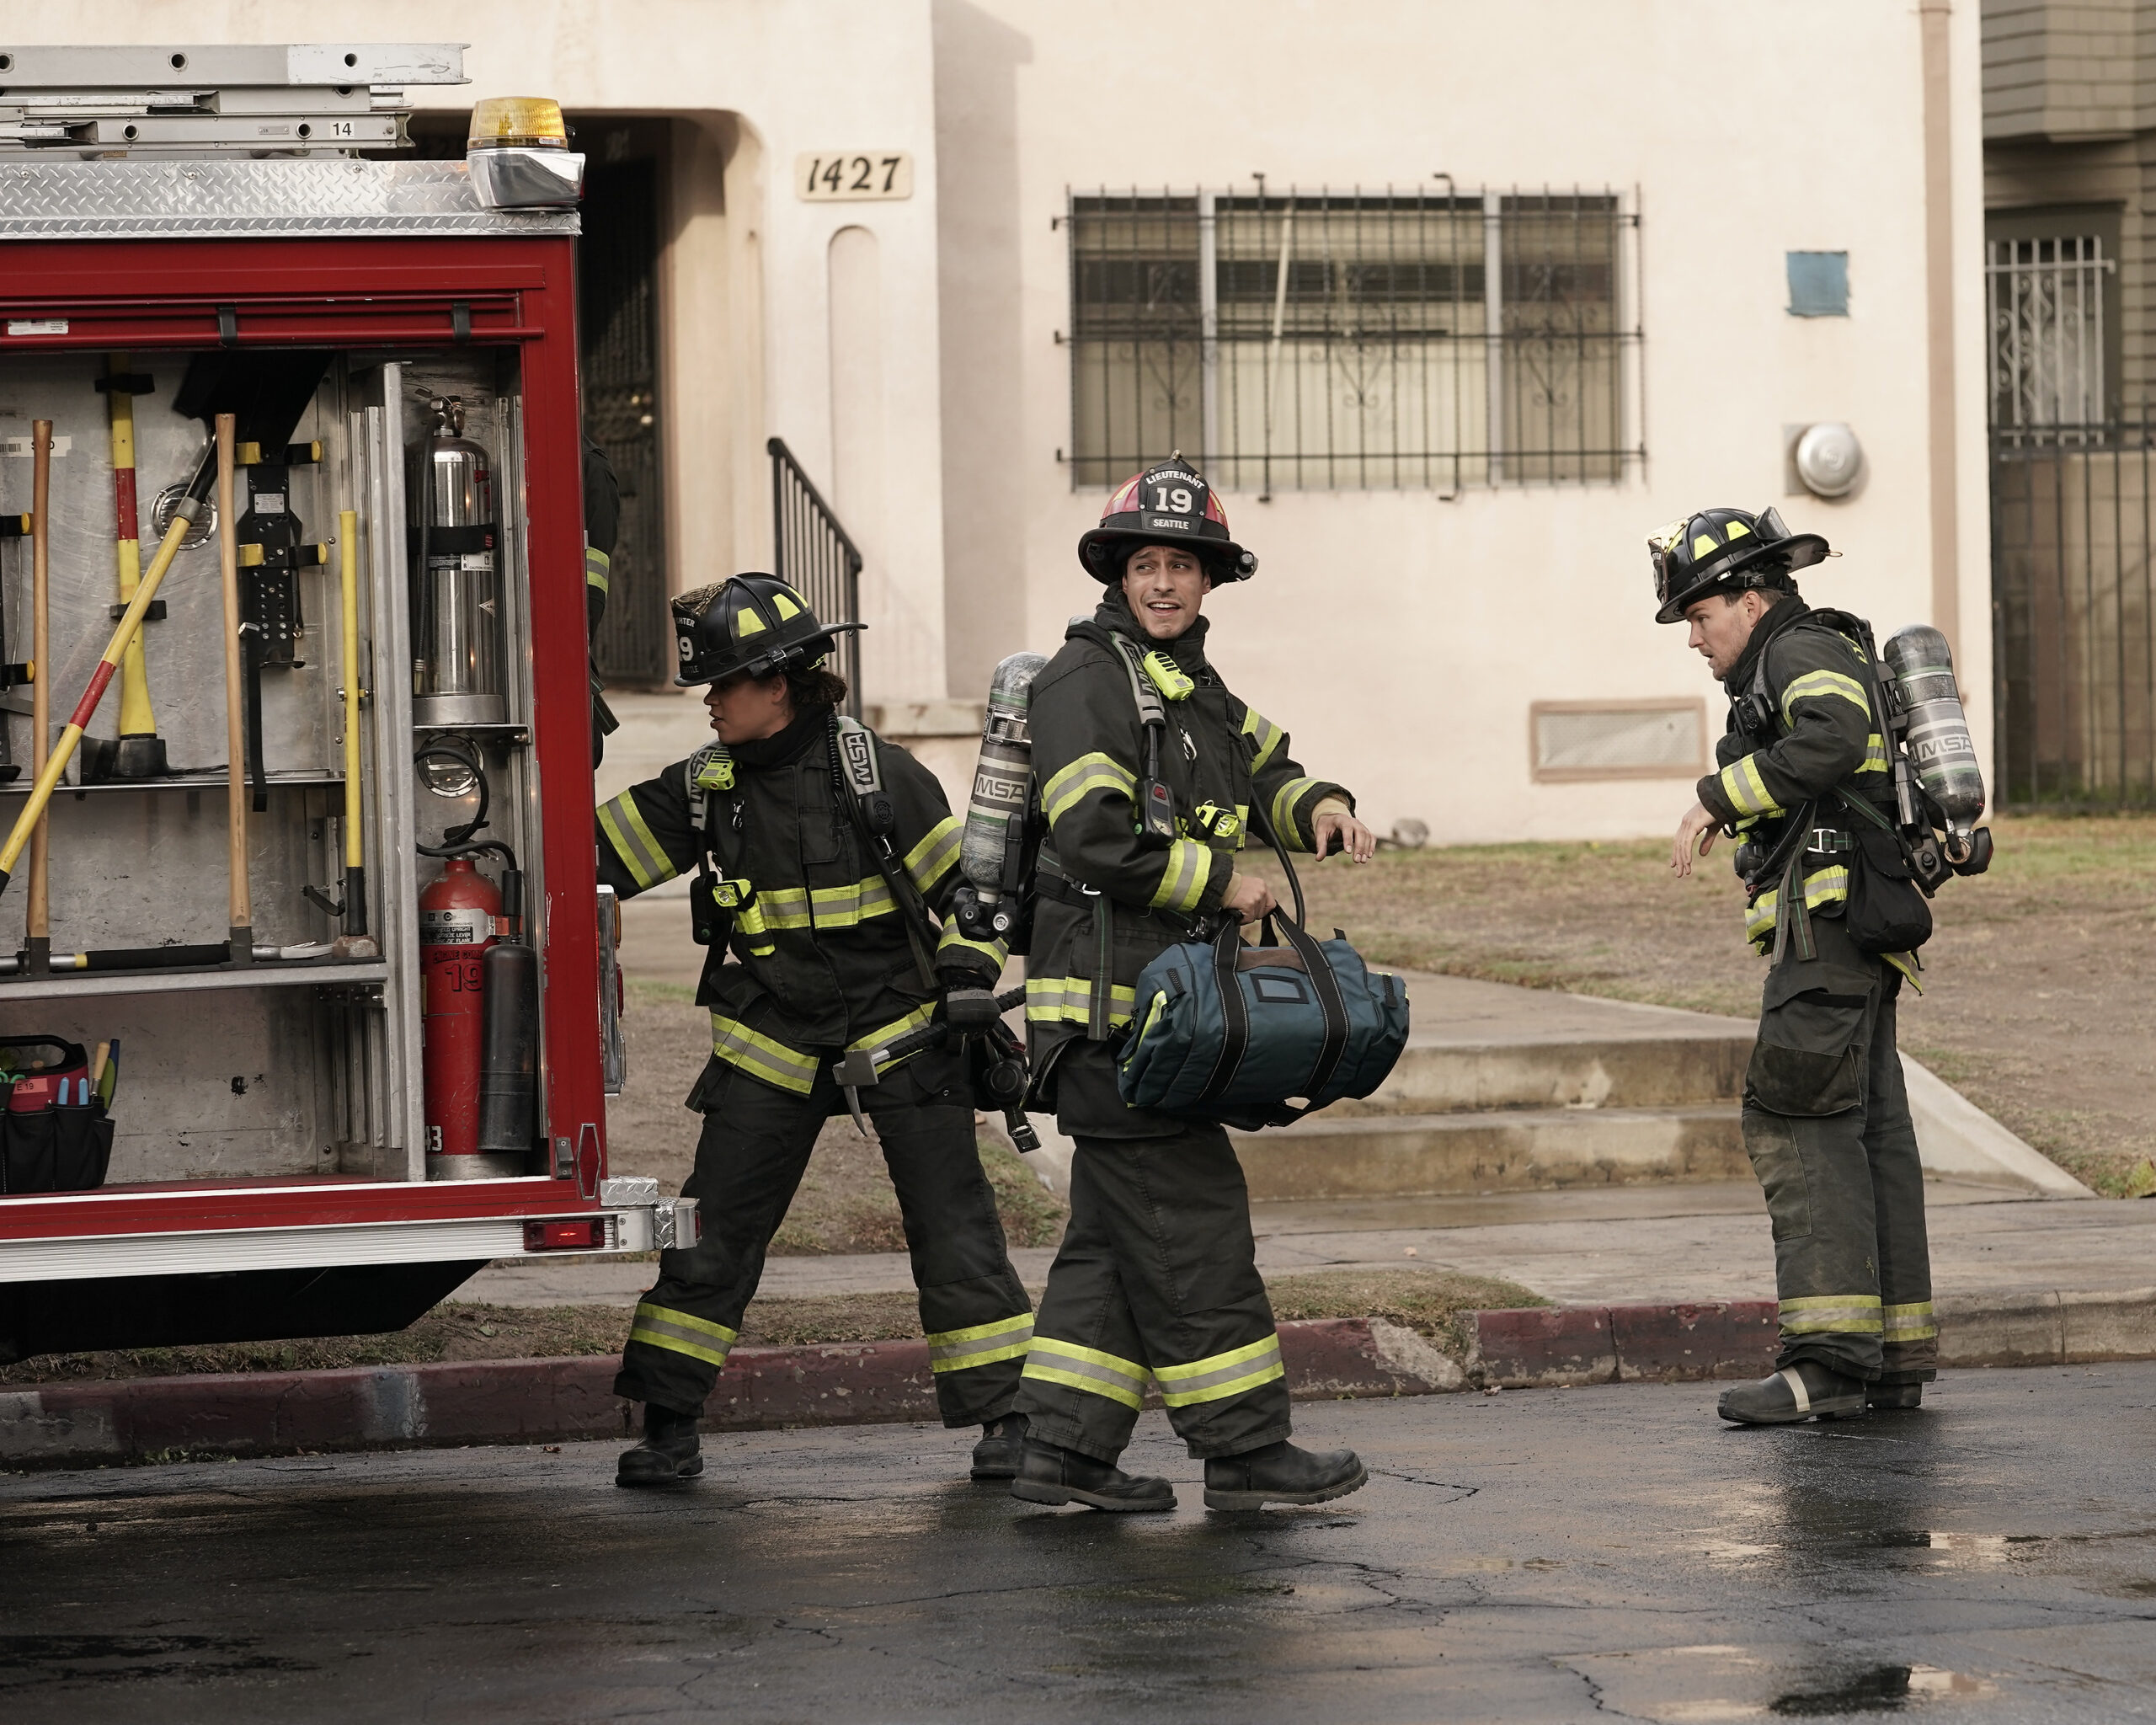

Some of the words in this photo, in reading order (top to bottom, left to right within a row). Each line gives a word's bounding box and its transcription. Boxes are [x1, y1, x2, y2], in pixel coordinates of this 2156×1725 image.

[333, 122, 352, 136] 14
[808, 156, 902, 193] 1427
[1145, 470, 1205, 489] LIEUTENANT
[1155, 487, 1193, 514] 19
[1153, 518, 1189, 531] SEATTLE
[846, 733, 872, 782] MSA
[1921, 736, 1972, 760] MSA
[976, 777, 1026, 801] MSA
[444, 964, 483, 992] 19
